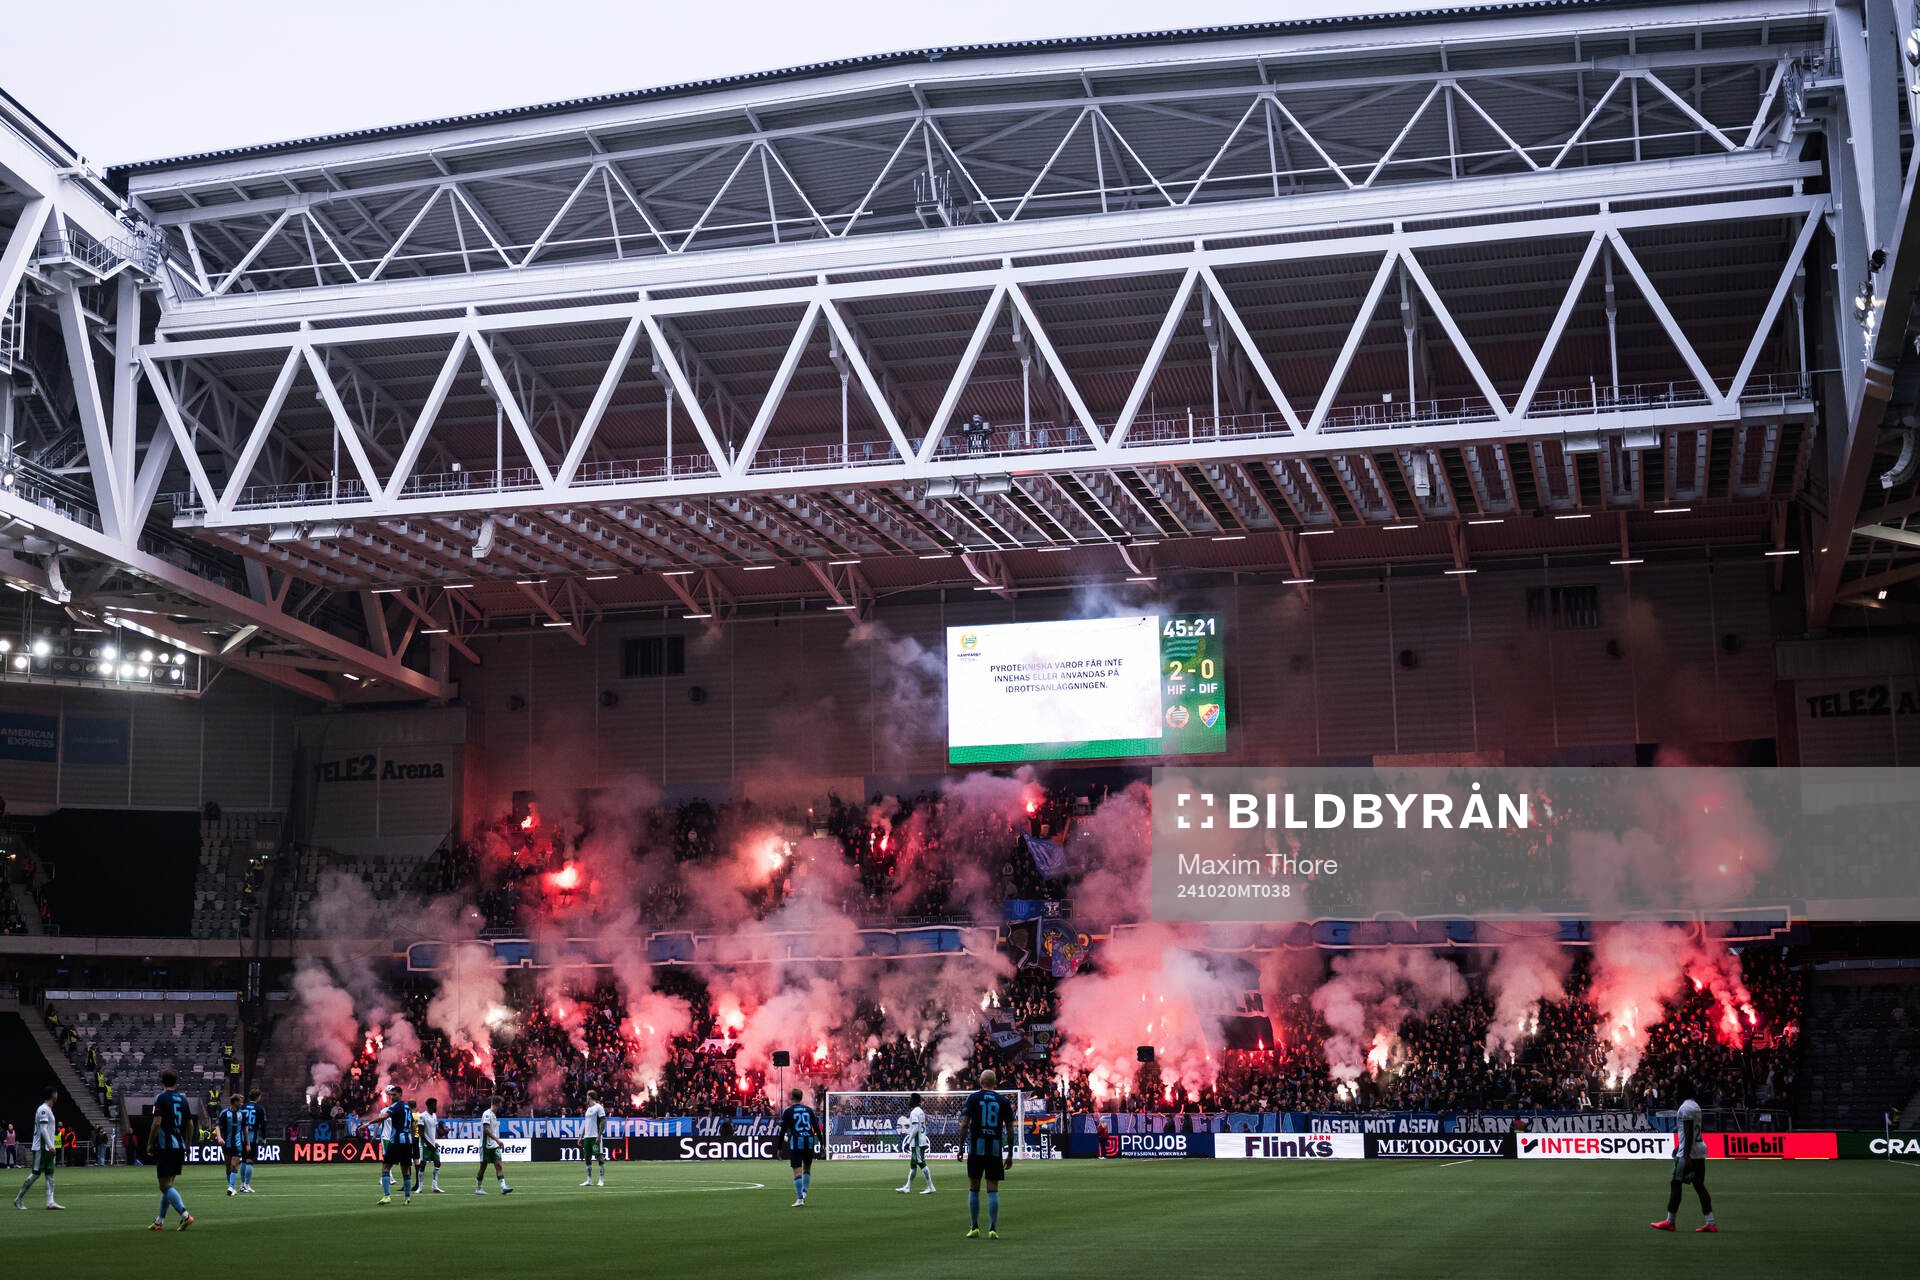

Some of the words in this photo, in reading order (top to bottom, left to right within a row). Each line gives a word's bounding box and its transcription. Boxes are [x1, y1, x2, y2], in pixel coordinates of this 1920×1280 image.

[1163, 618, 1215, 637] 45:21
[990, 662, 1053, 673] PYROTEKNISKA
[1055, 661, 1084, 670] VAROR
[1086, 658, 1102, 668] FÅR
[1105, 658, 1123, 667] INTE
[1169, 660, 1183, 681] 2
[1201, 659, 1215, 679] 0
[994, 673, 1031, 684] INNEHAS
[1033, 672, 1058, 682] ELLER
[1108, 667, 1120, 677] PÅ
[1167, 684, 1187, 696] HIF
[1199, 683, 1218, 694] DIF
[1806, 685, 1891, 718] TELE2
[0, 727, 55, 740] AMERICAN
[8, 736, 55, 748] EXPRESS
[313, 755, 377, 782] TELE2
[381, 760, 445, 780] Arena
[173, 1103, 183, 1127] 5
[793, 1112, 811, 1132] 29
[979, 1100, 1000, 1128] 18
[293, 1142, 340, 1162] MBF
[679, 1137, 774, 1159] Scandic
[1120, 1135, 1188, 1150] PROJOB
[1245, 1136, 1334, 1157] Flinks
[1376, 1138, 1504, 1155] METODGOLV
[1541, 1138, 1666, 1154] INTERSPORT
[256, 1145, 281, 1161] BAR
